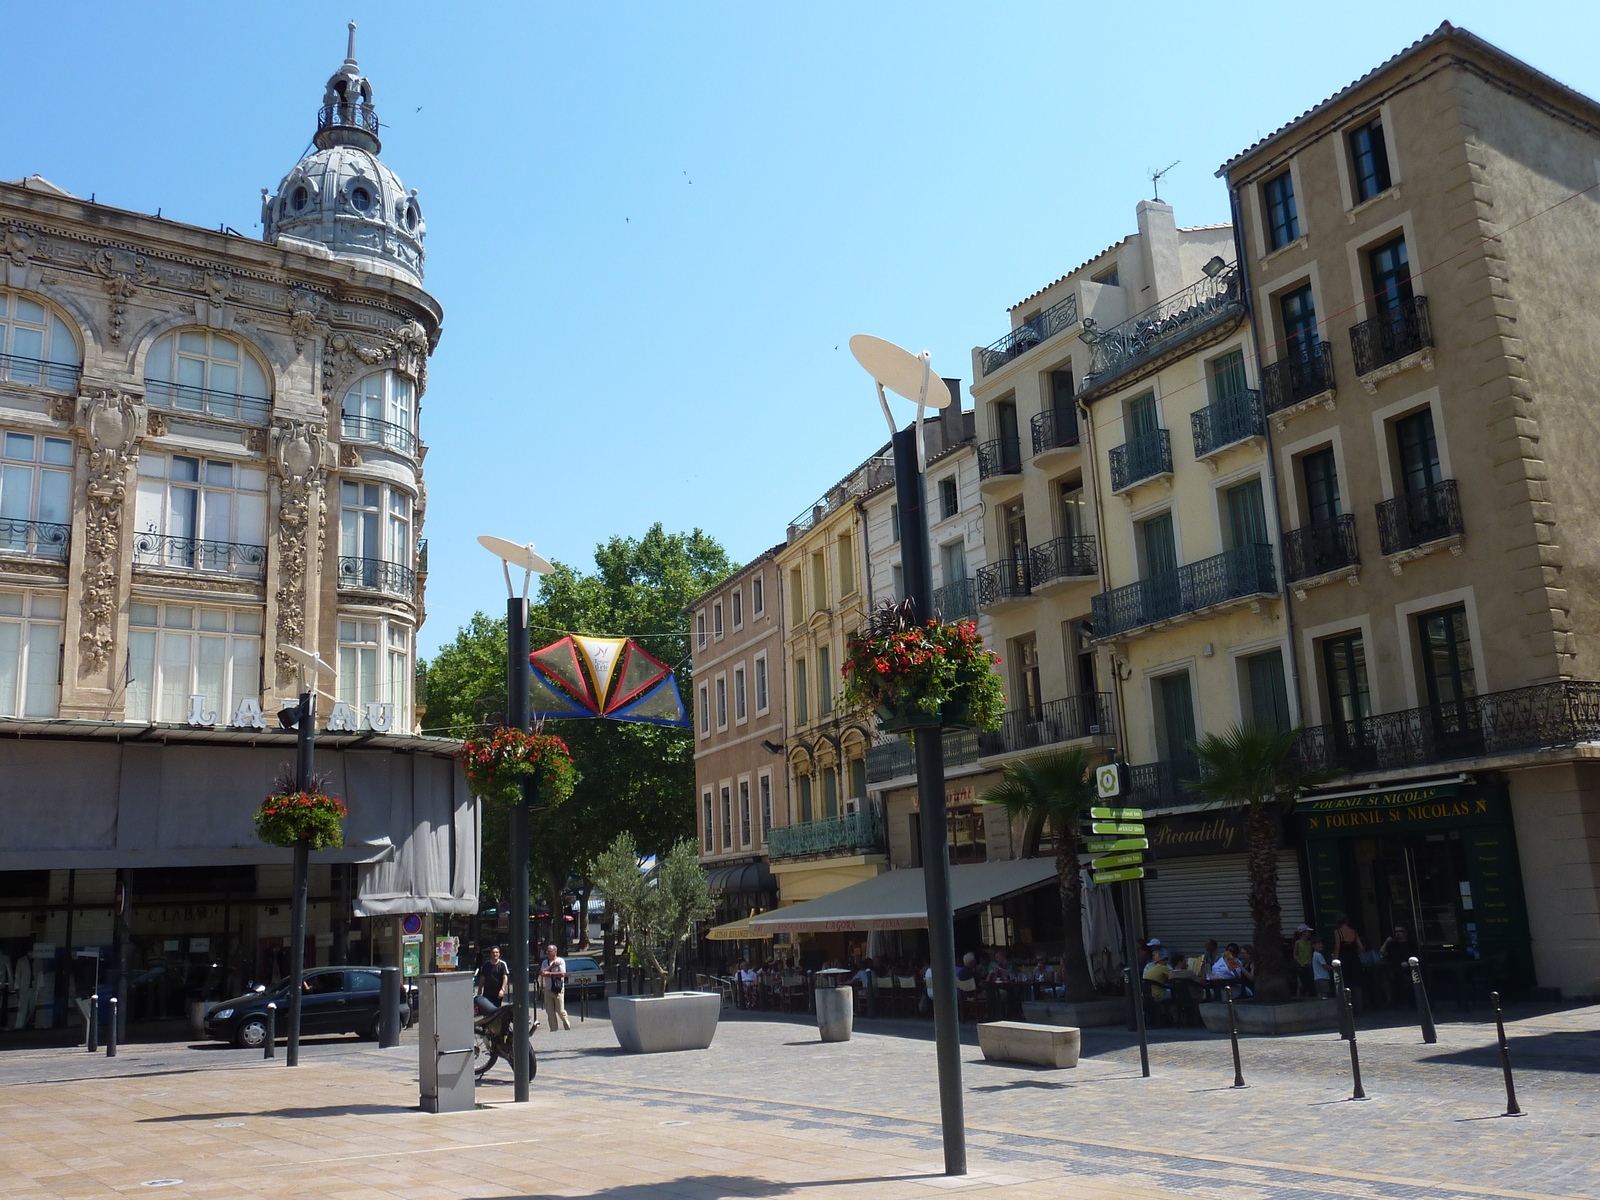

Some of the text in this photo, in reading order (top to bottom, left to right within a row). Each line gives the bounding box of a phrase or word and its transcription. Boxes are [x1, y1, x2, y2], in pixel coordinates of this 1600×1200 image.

[1313, 789, 1436, 809] FOURNIL St NICOLAS
[1325, 813, 1384, 828] FOURNIL
[1389, 808, 1402, 822] St
[1407, 801, 1470, 820] NICOLAS
[1153, 819, 1239, 849] Piccadilly
